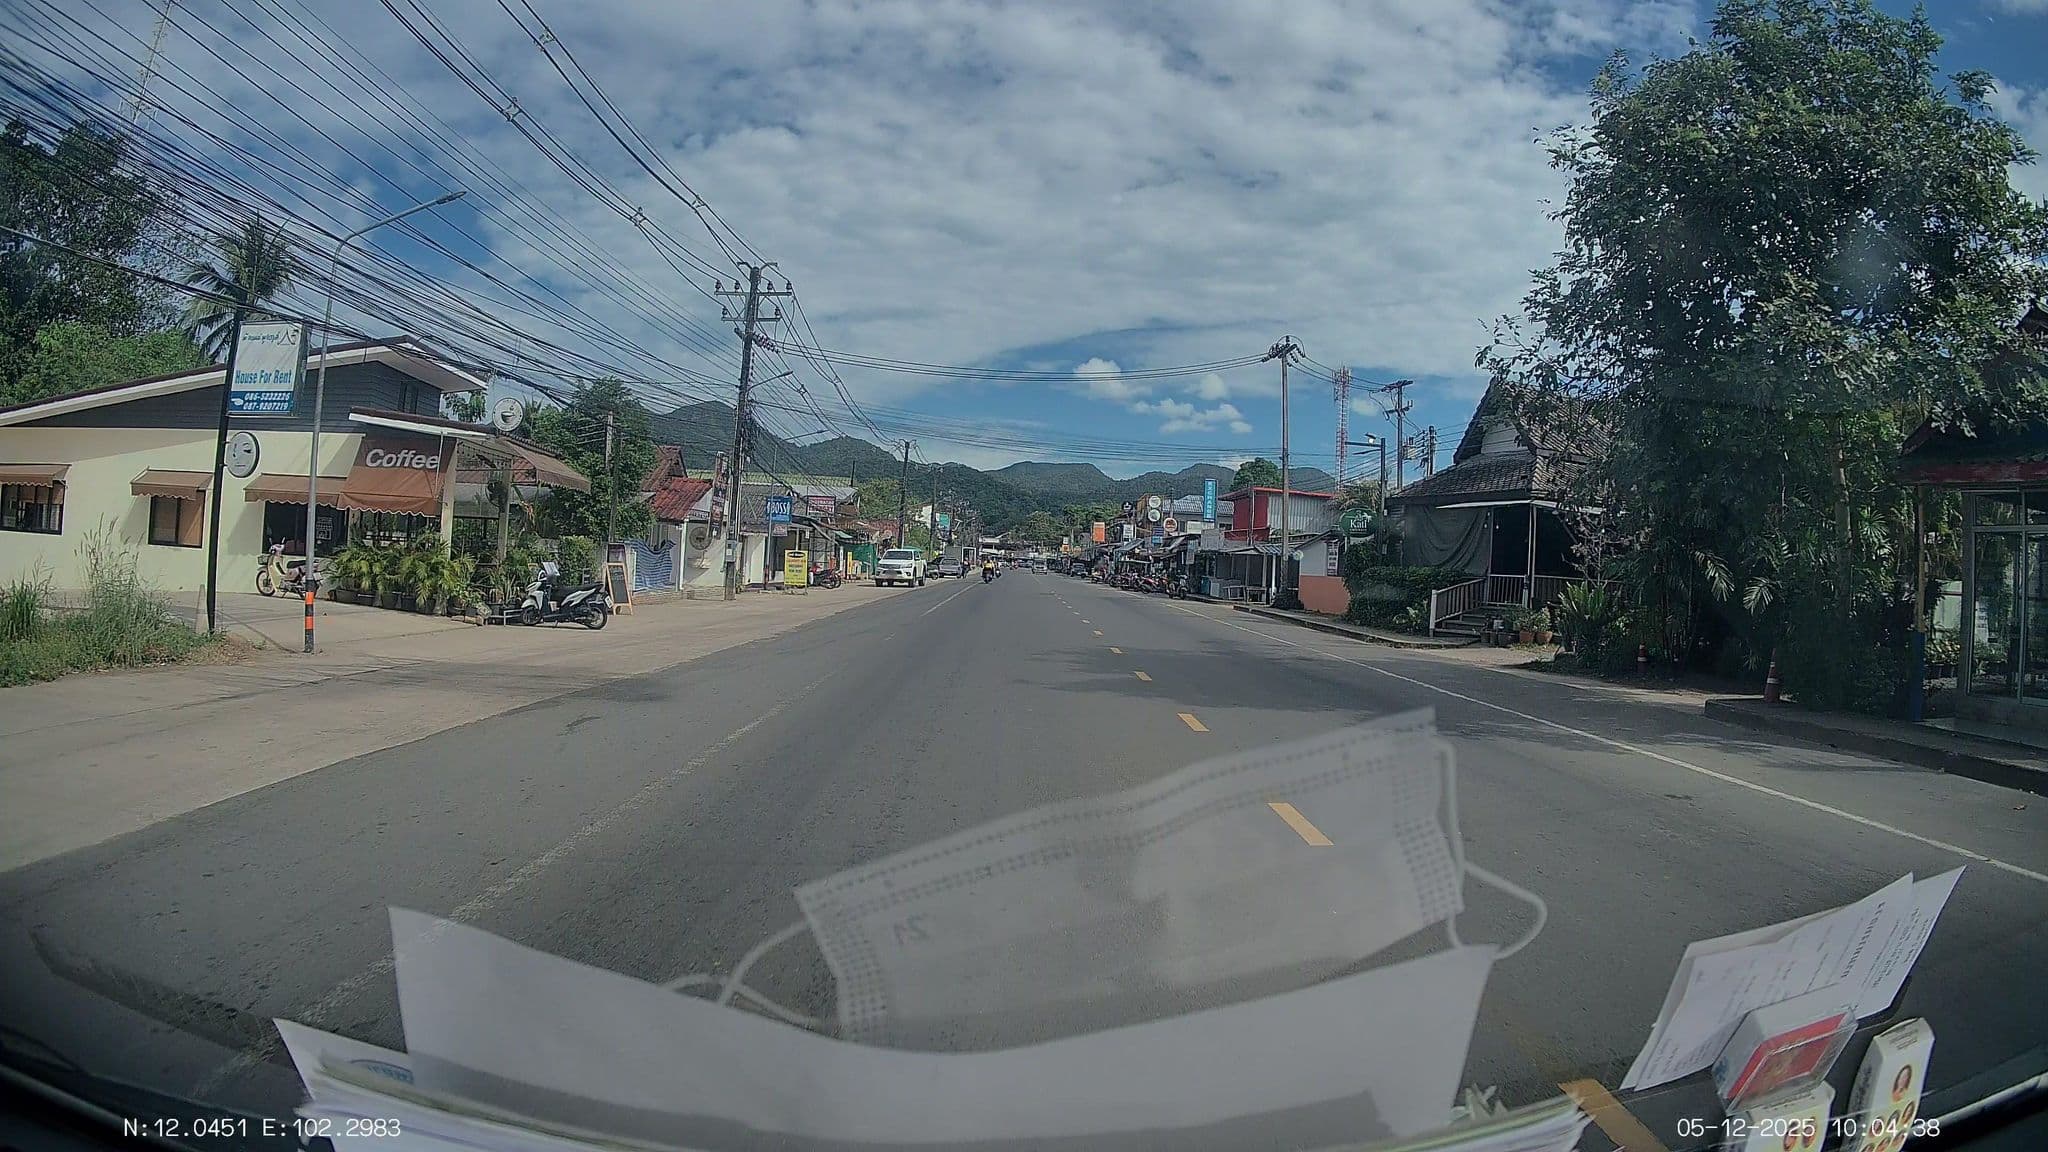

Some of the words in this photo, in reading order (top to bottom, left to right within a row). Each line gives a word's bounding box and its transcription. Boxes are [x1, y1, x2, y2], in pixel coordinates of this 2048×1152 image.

[235, 370, 258, 384] House
[259, 370, 272, 384] For
[273, 369, 292, 384] Rent
[366, 448, 440, 469] Coffee
